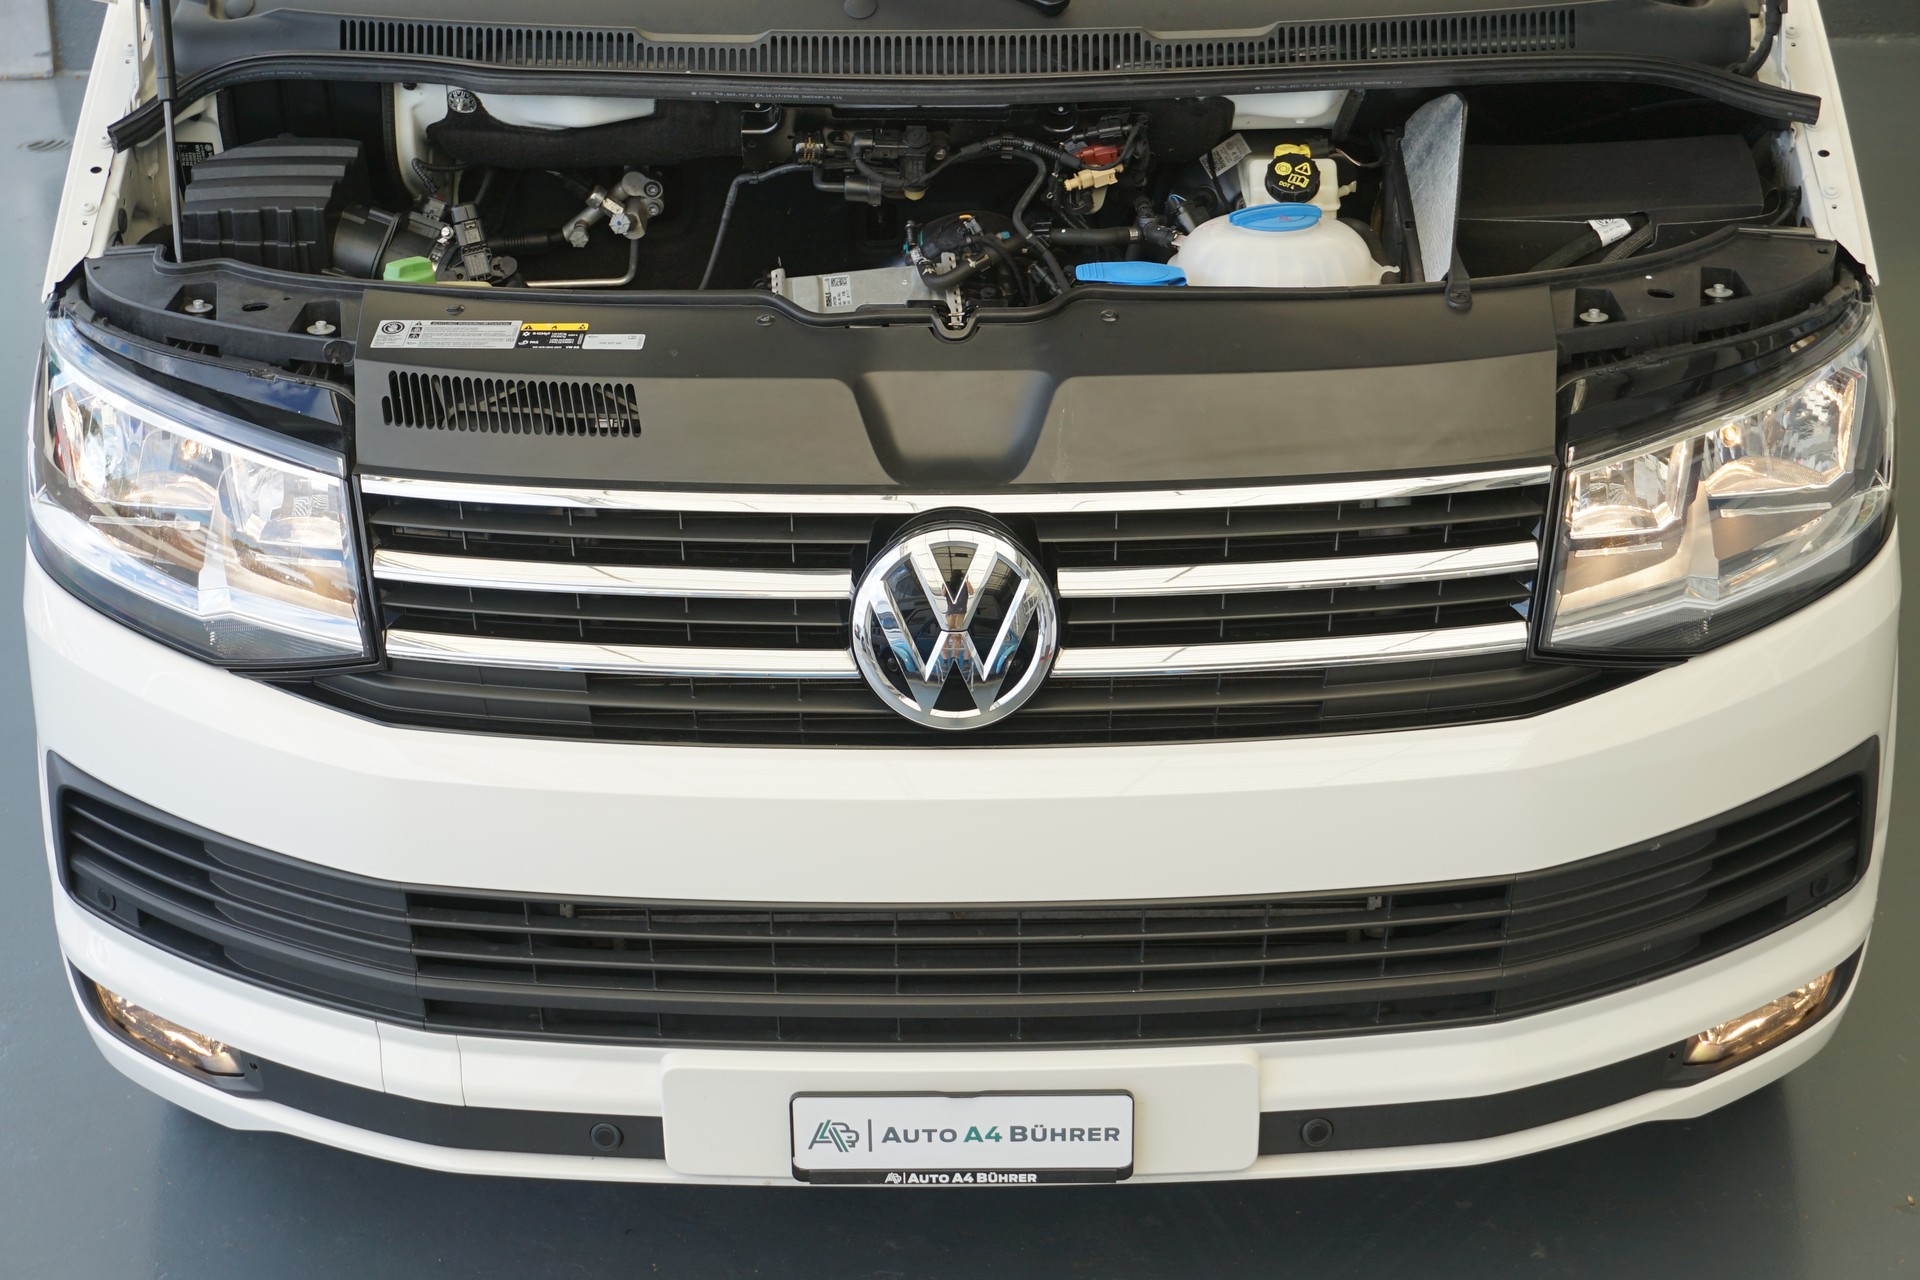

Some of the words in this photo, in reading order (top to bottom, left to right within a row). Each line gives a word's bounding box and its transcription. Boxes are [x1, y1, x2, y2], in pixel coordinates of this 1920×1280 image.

[963, 1125, 1002, 1142] A4
[1010, 1124, 1120, 1142] BÜHRER
[952, 1172, 974, 1183] A4
[976, 1172, 1037, 1183] BÜHRER
